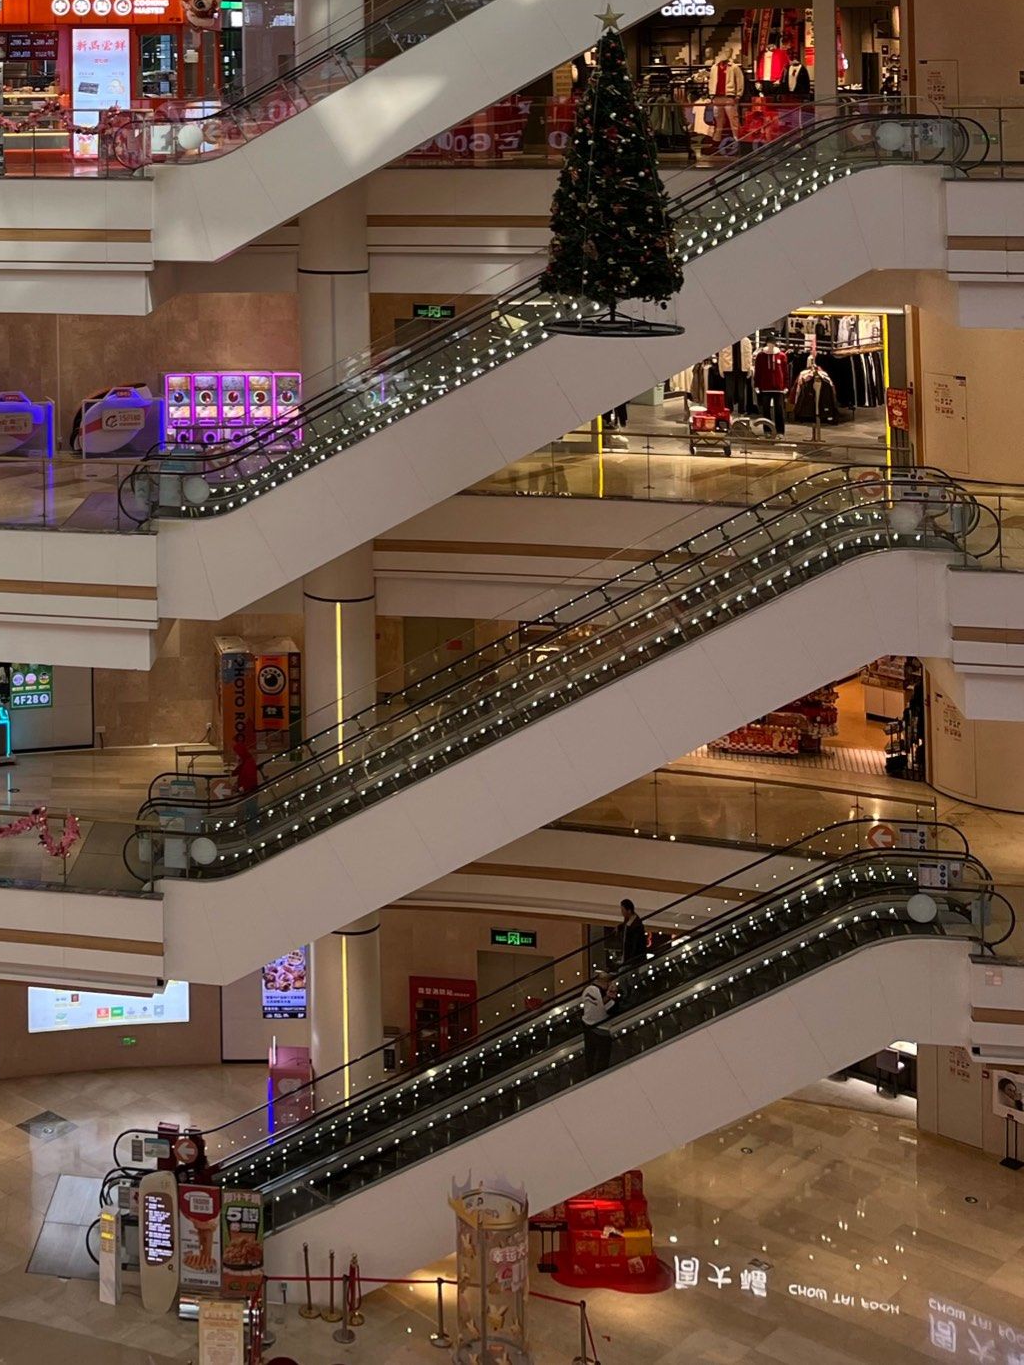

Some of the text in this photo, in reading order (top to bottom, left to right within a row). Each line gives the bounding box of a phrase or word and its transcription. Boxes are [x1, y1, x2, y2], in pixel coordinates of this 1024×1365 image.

[661, 2, 715, 16] adidas
[234, 657, 245, 707] PHOTO
[13, 694, 39, 705] 4F28
